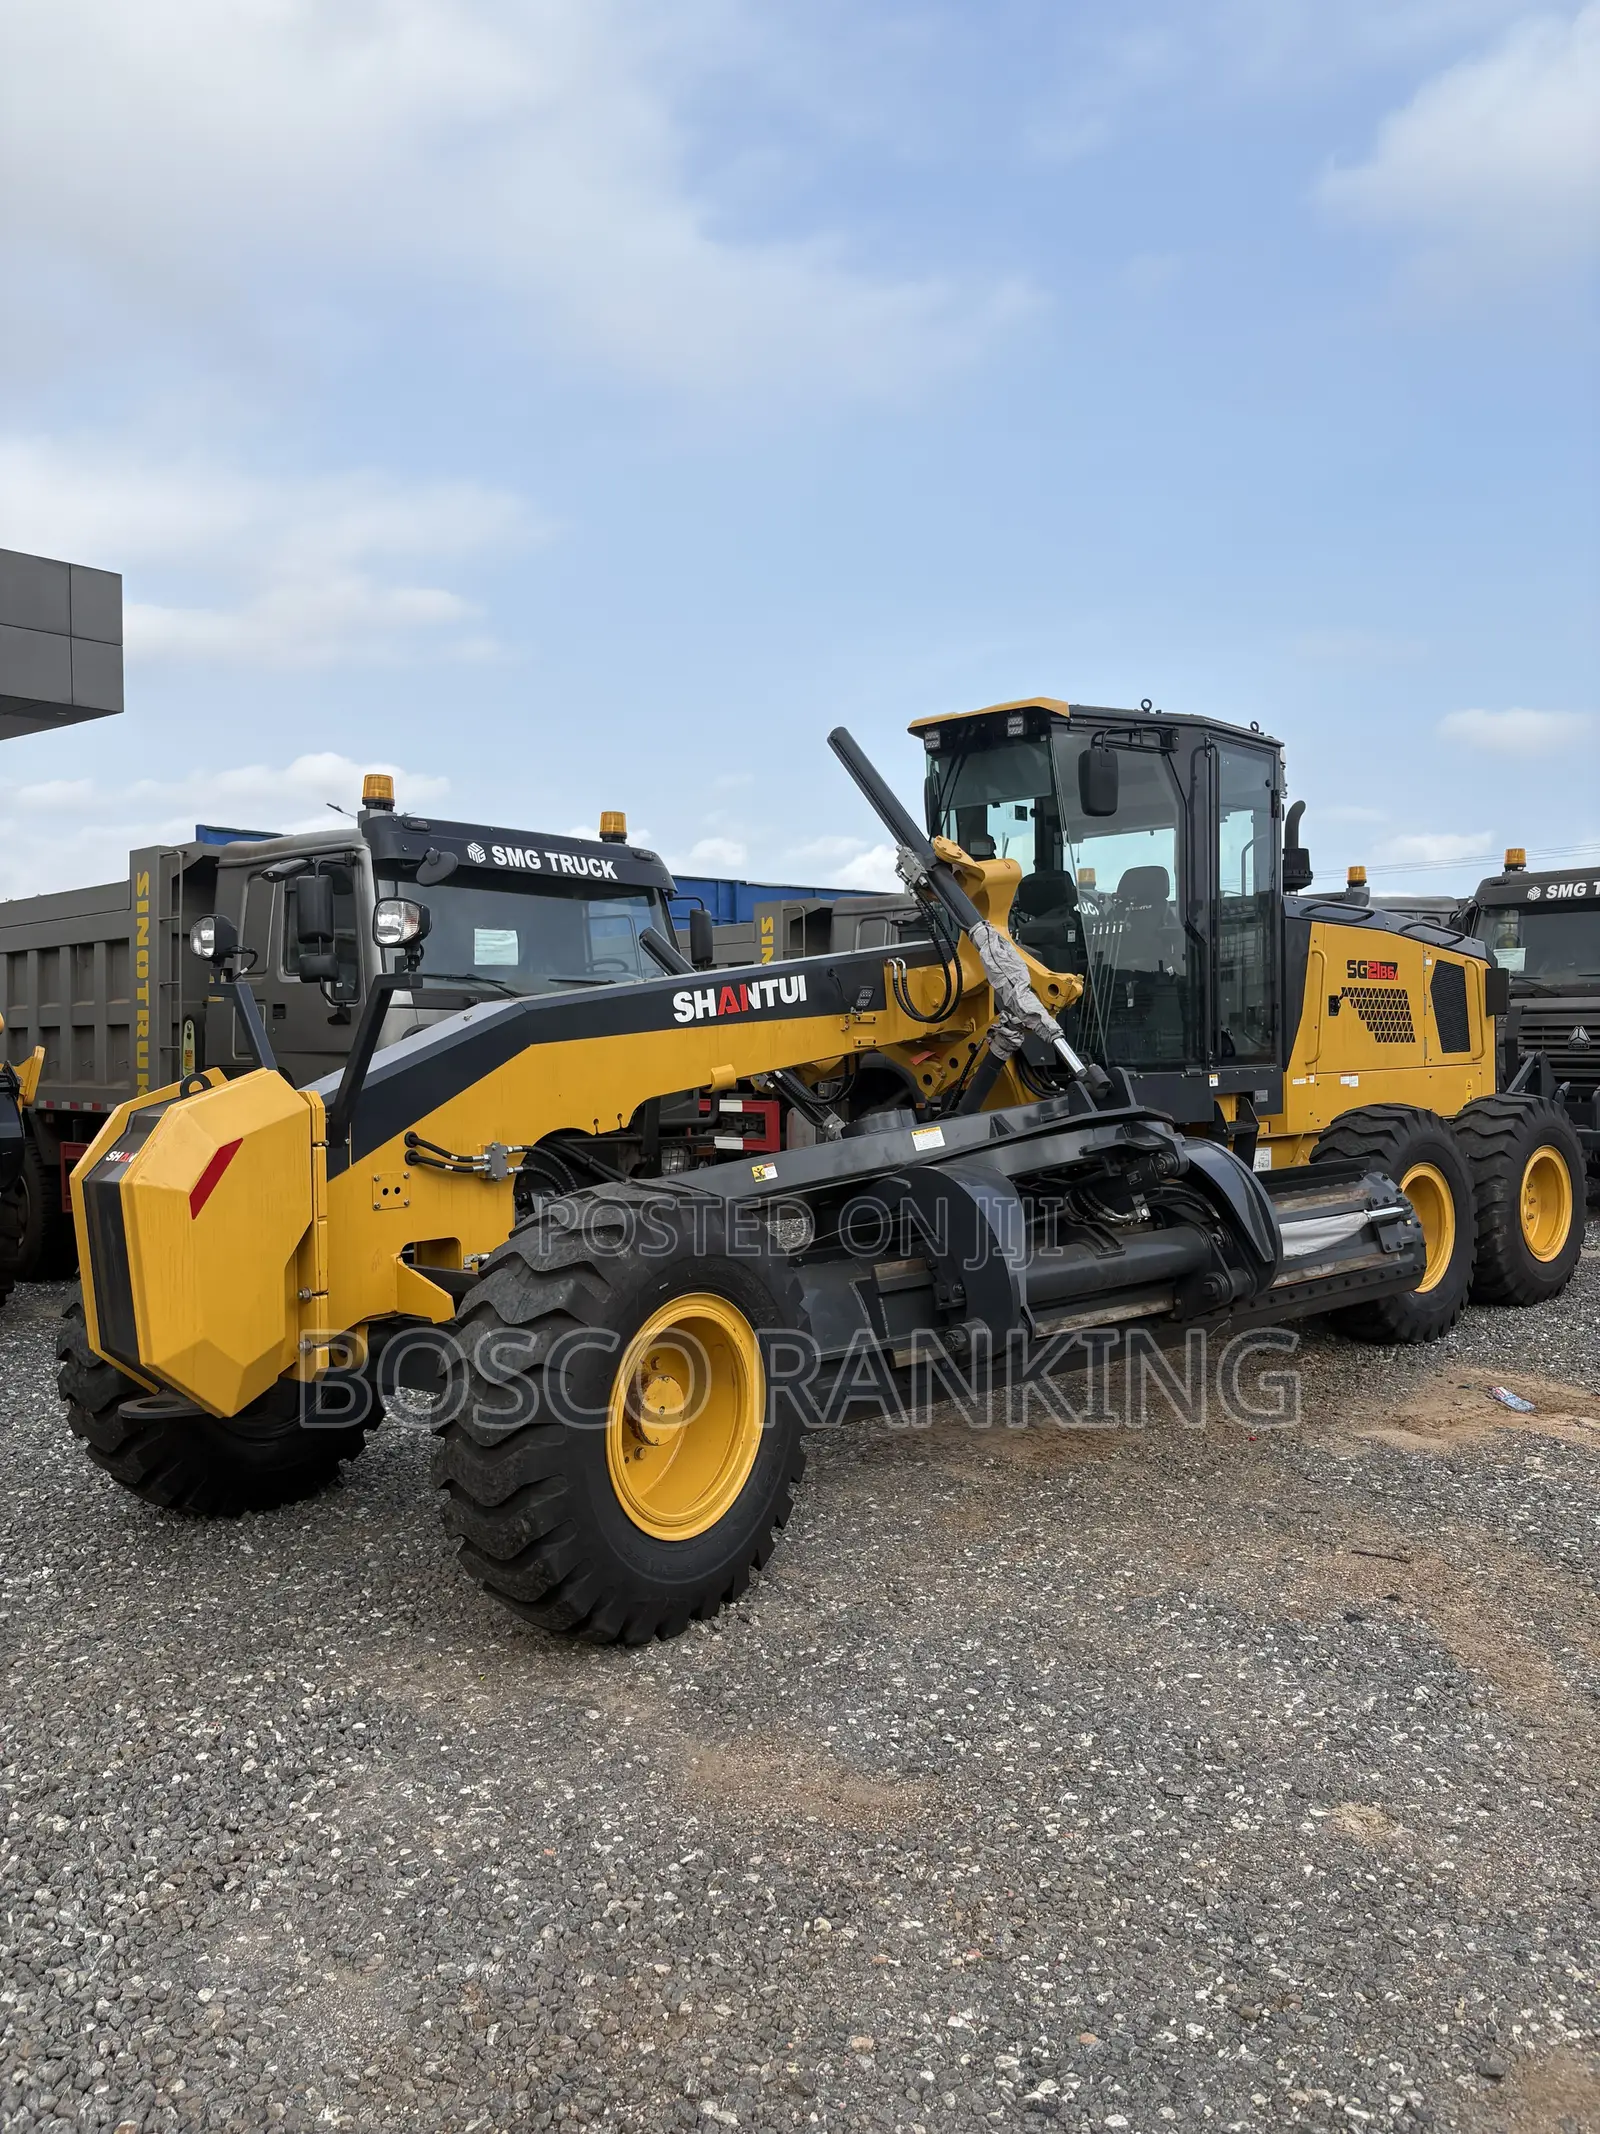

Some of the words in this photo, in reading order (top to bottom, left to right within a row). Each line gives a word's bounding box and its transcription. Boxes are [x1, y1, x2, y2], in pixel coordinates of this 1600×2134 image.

[491, 845, 542, 870] SMG
[544, 851, 618, 880] TRUCK
[1546, 882, 1587, 899] SMG
[136, 870, 150, 1097] SINOTRUK
[672, 974, 808, 1023] SHANTUI
